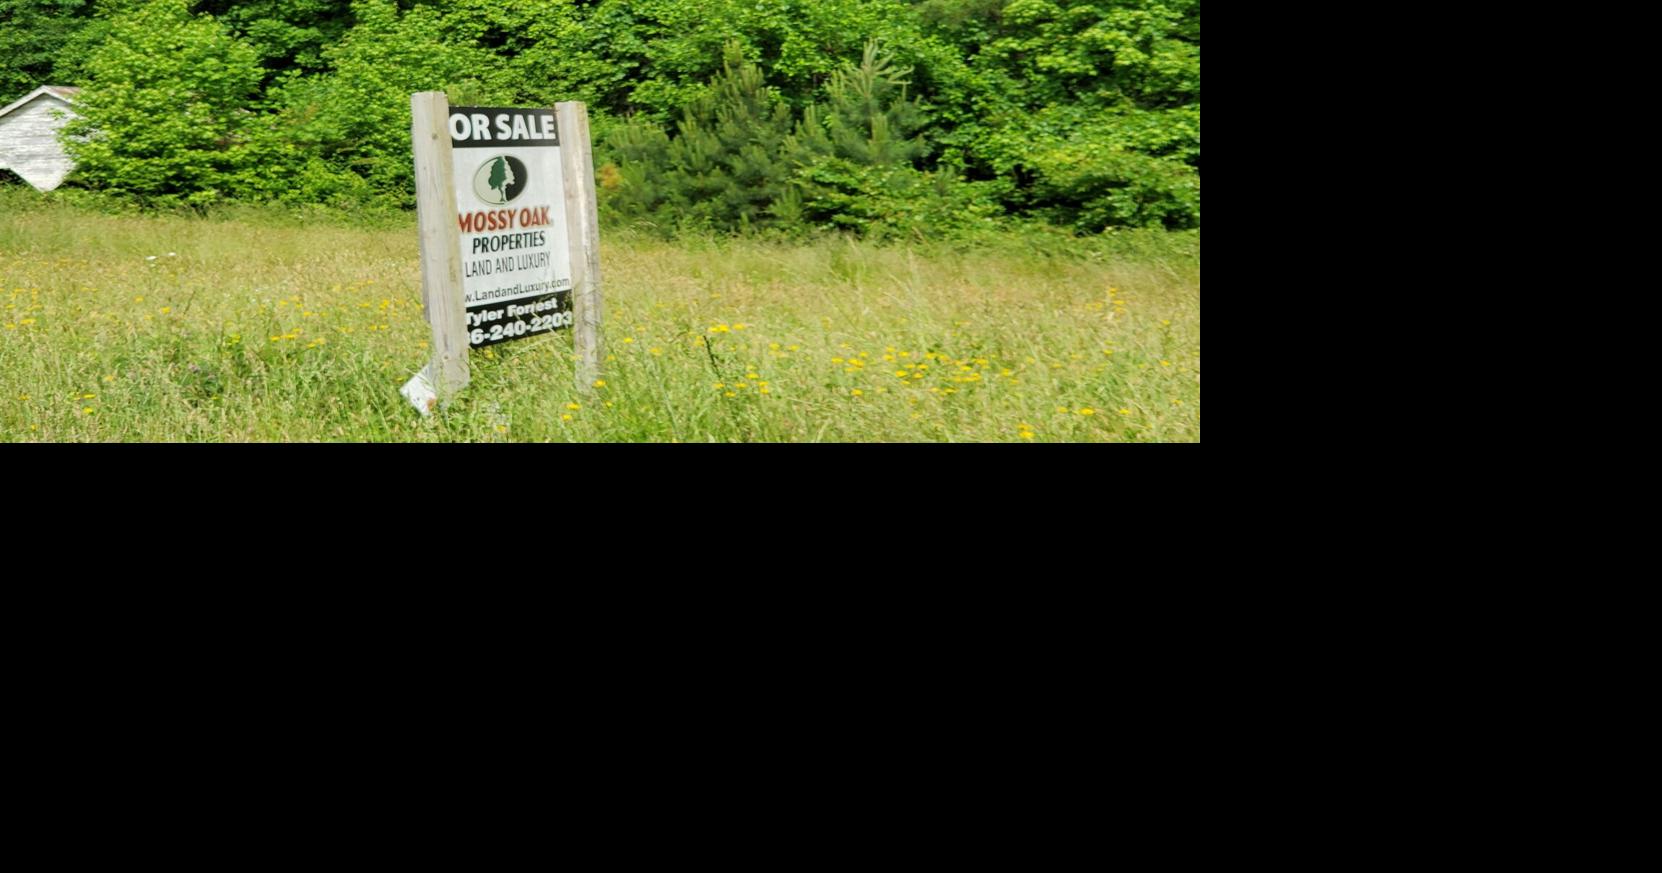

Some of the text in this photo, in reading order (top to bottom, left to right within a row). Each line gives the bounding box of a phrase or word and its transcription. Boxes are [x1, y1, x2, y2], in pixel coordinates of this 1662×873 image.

[449, 113, 556, 140] OR SALE
[458, 206, 550, 233] MOSSY OAK
[472, 230, 546, 254] PROPERTIES
[465, 251, 551, 277] LAND AND LUXURY
[466, 297, 558, 327] Tyler Forrest
[467, 310, 573, 345] 6-240-2203
